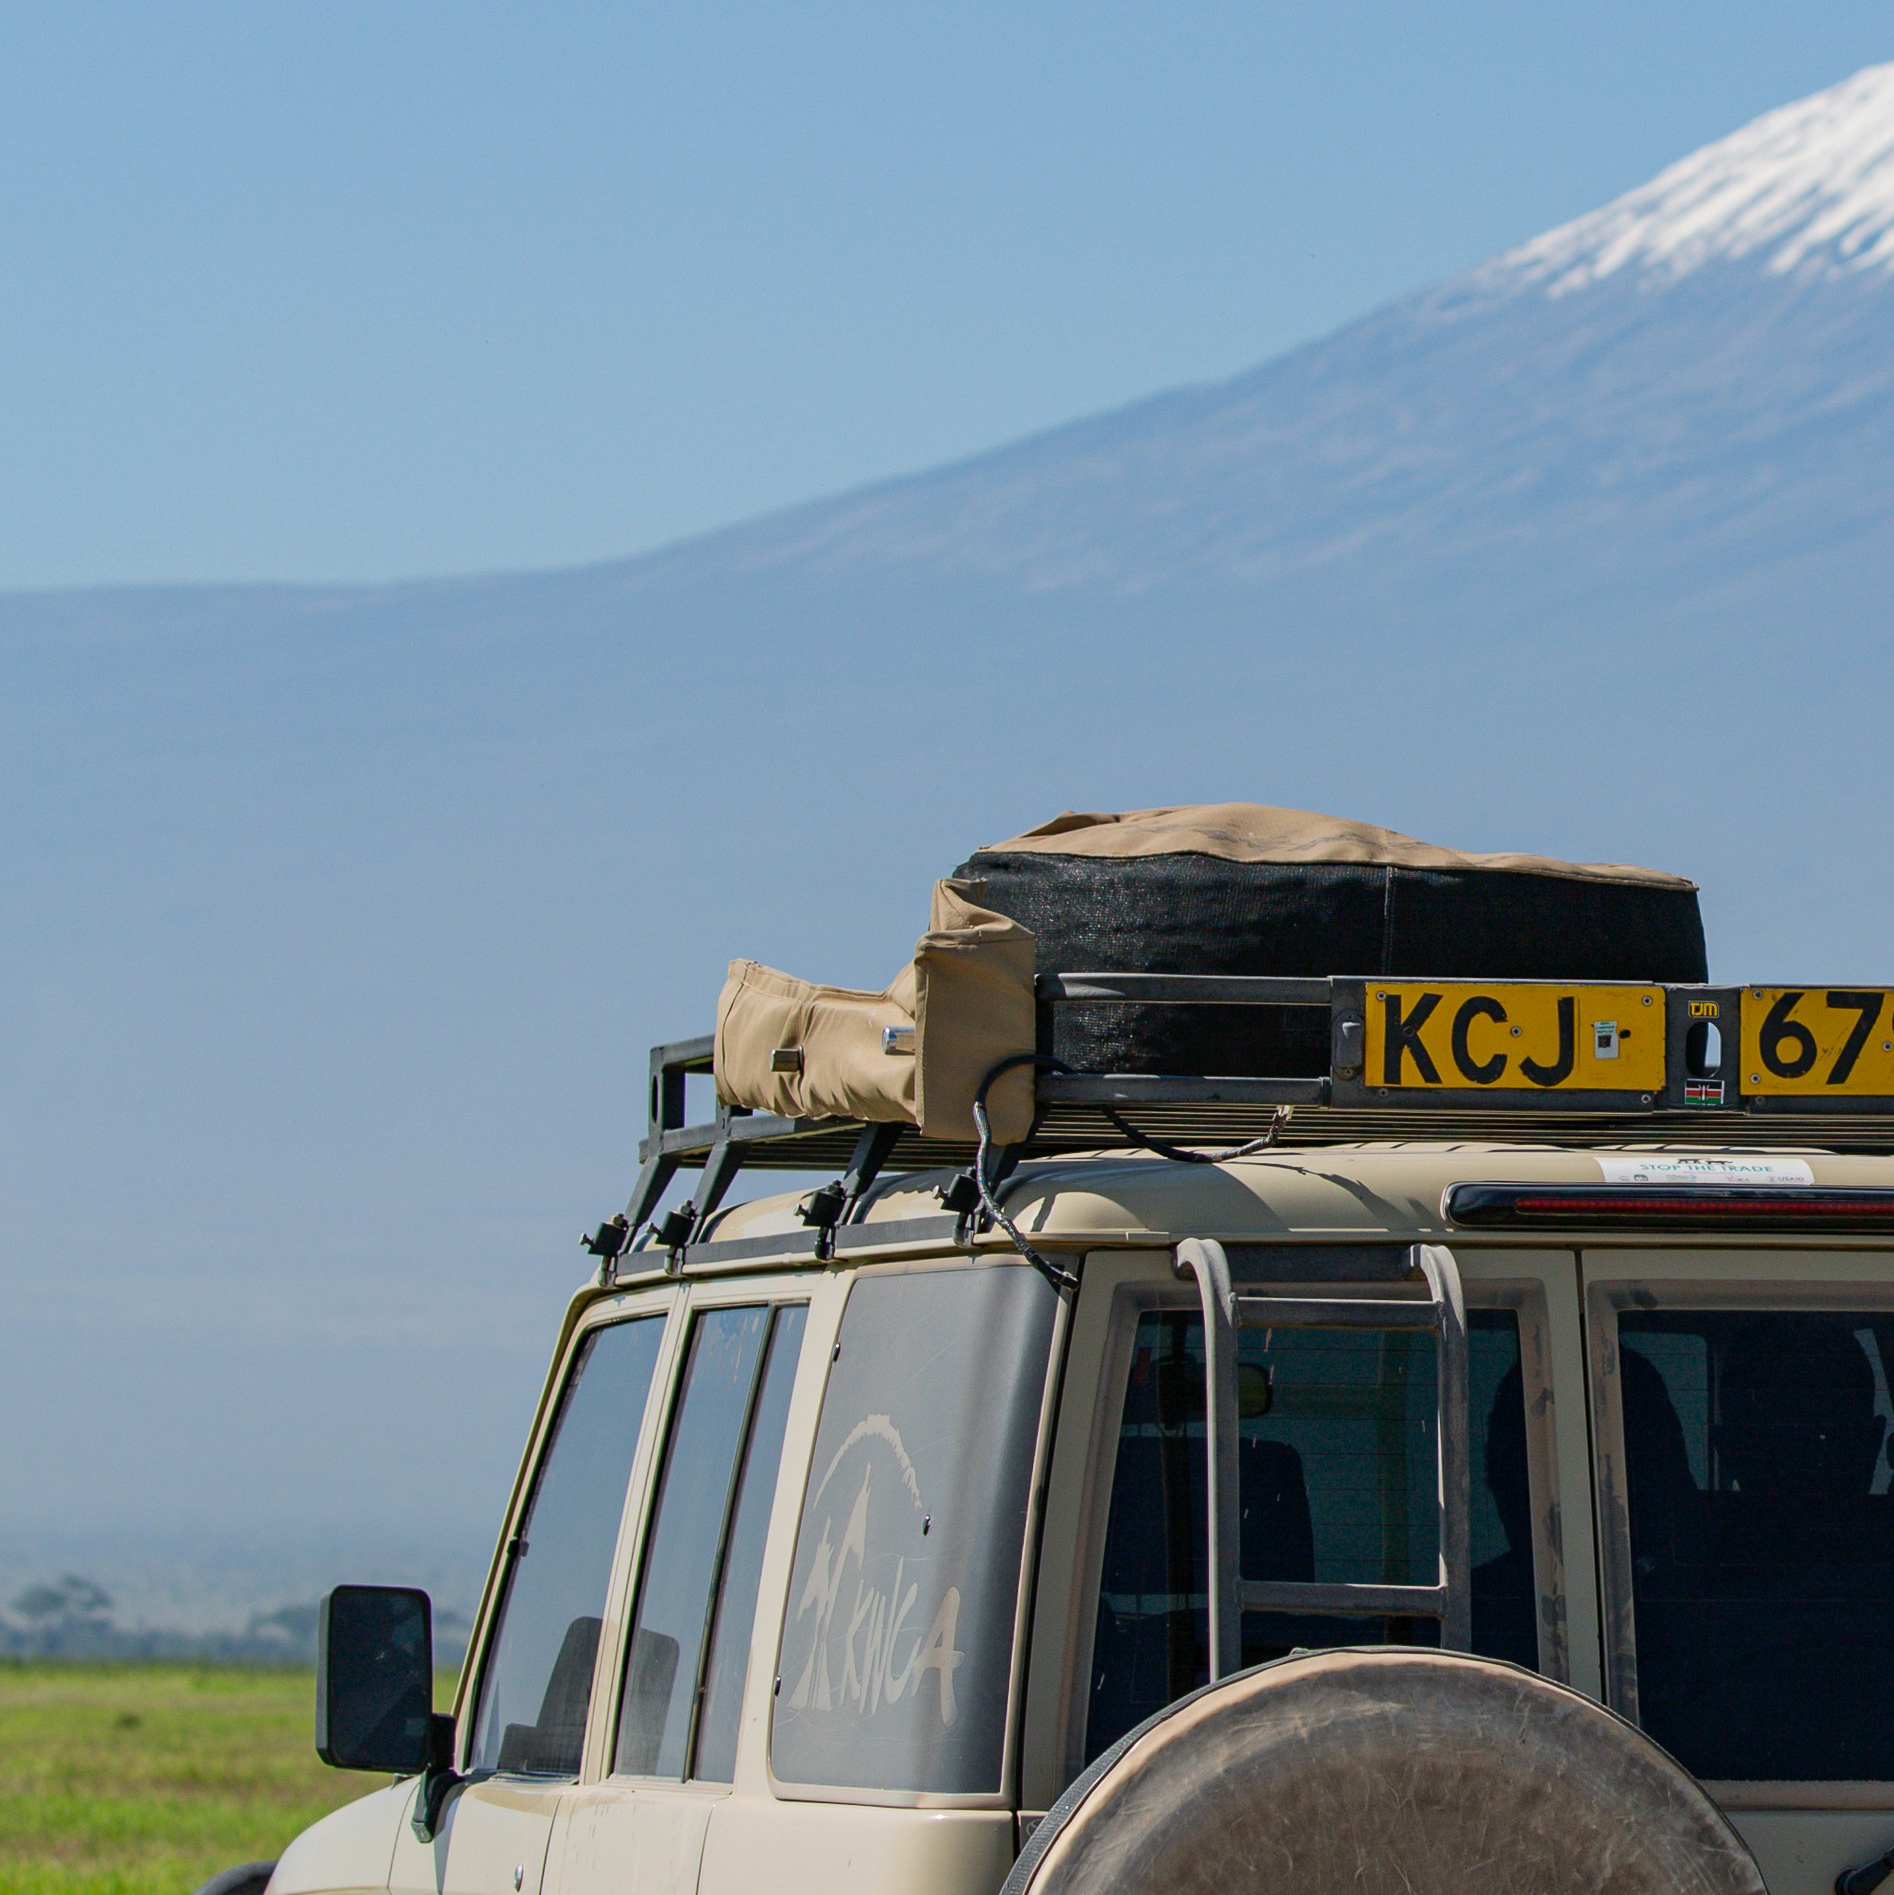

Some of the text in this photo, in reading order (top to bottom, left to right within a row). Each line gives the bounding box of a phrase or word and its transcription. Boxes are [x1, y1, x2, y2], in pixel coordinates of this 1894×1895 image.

[1690, 1002, 1718, 1016] TJM
[1383, 992, 1575, 1087] KCJ
[1640, 1163, 1678, 1171] STOP
[1687, 1164, 1714, 1172] THE
[1720, 1165, 1773, 1173] TRADE
[839, 1557, 965, 1727] KWCA
